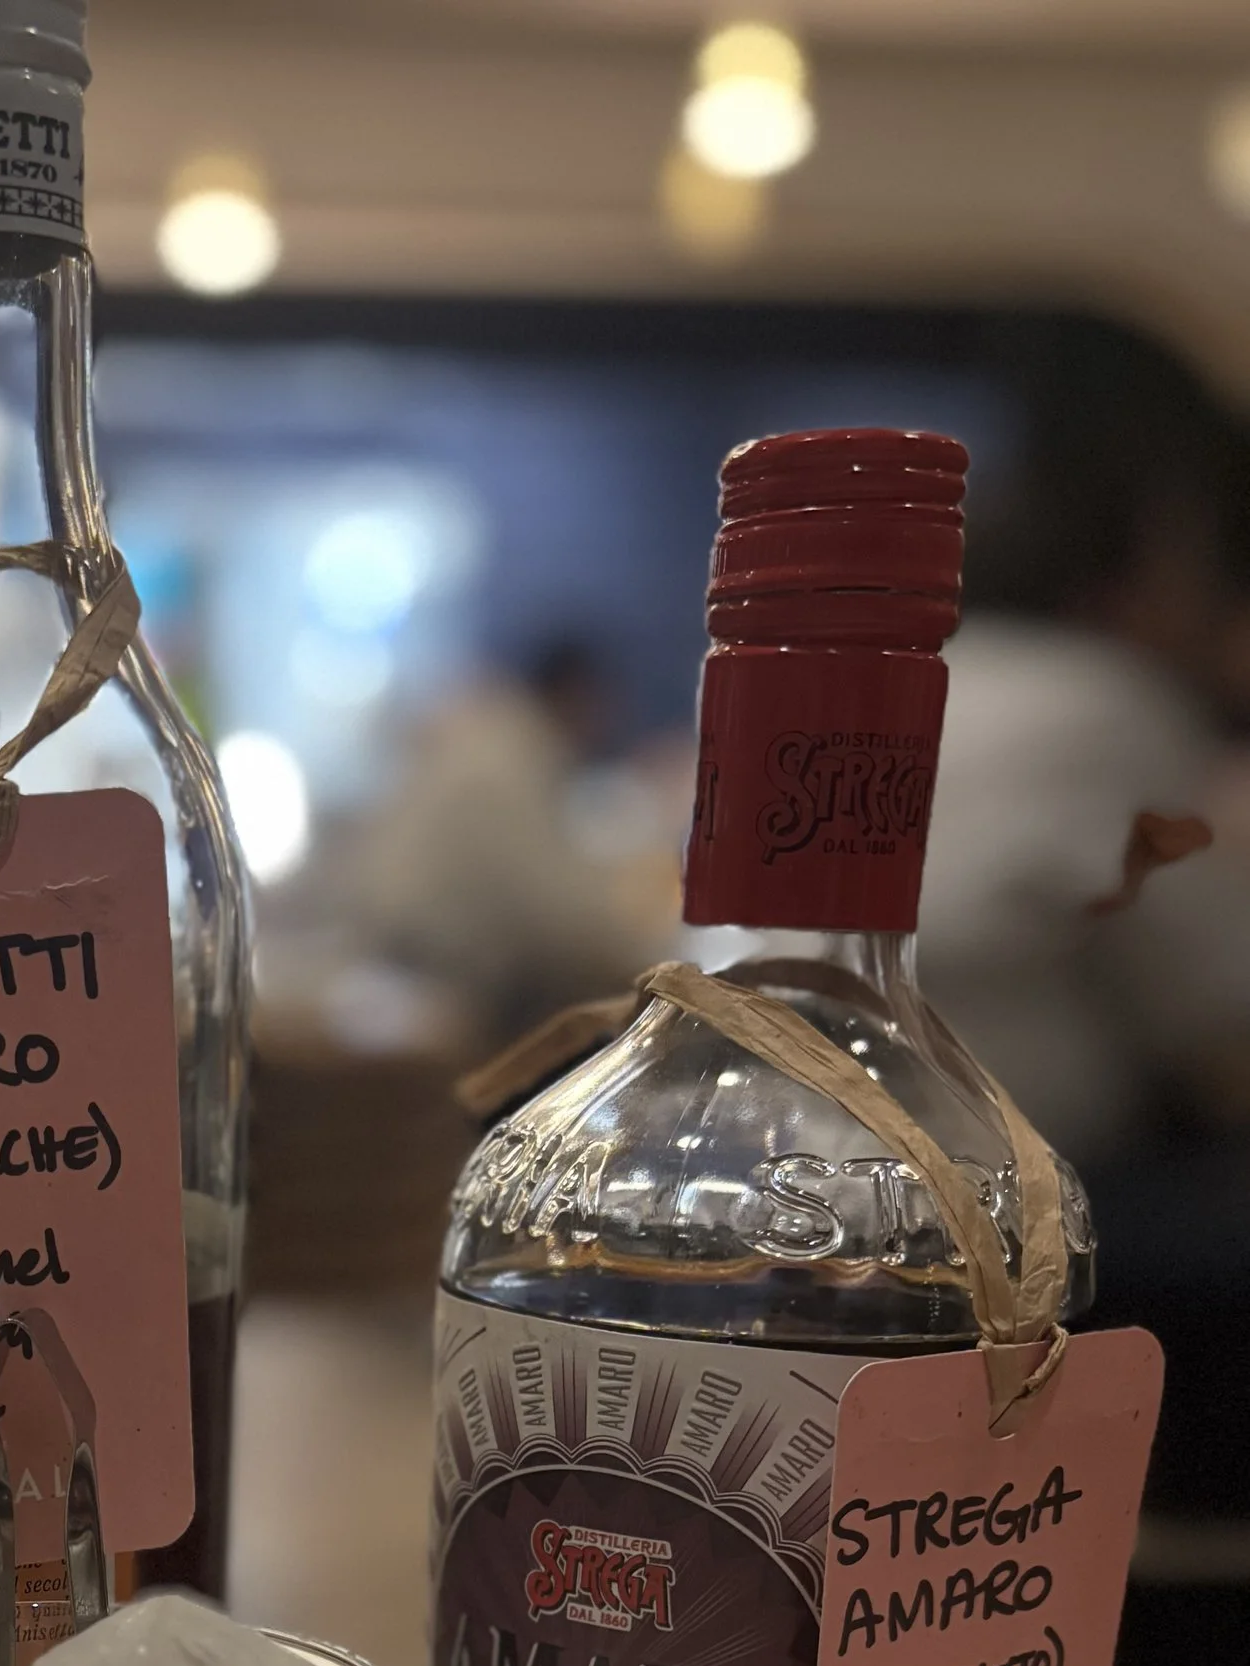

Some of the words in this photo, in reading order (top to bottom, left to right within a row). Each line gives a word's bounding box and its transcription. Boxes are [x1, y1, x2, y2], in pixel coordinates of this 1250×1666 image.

[822, 838, 858, 855] DAL
[459, 1368, 490, 1447] AMARO
[513, 1344, 547, 1428] AMARO
[597, 1346, 637, 1432] AMARO
[681, 1369, 743, 1459] AMARO
[761, 1417, 837, 1502] AMARO
[574, 1528, 670, 1557] DISTILLERIA
[832, 1465, 1082, 1566] STREGA
[23, 1570, 68, 1595] secol
[525, 1519, 675, 1630] STREGA
[838, 1559, 1052, 1657] AMARO
[569, 1607, 596, 1625] DAL
[600, 1612, 629, 1629] 1860
